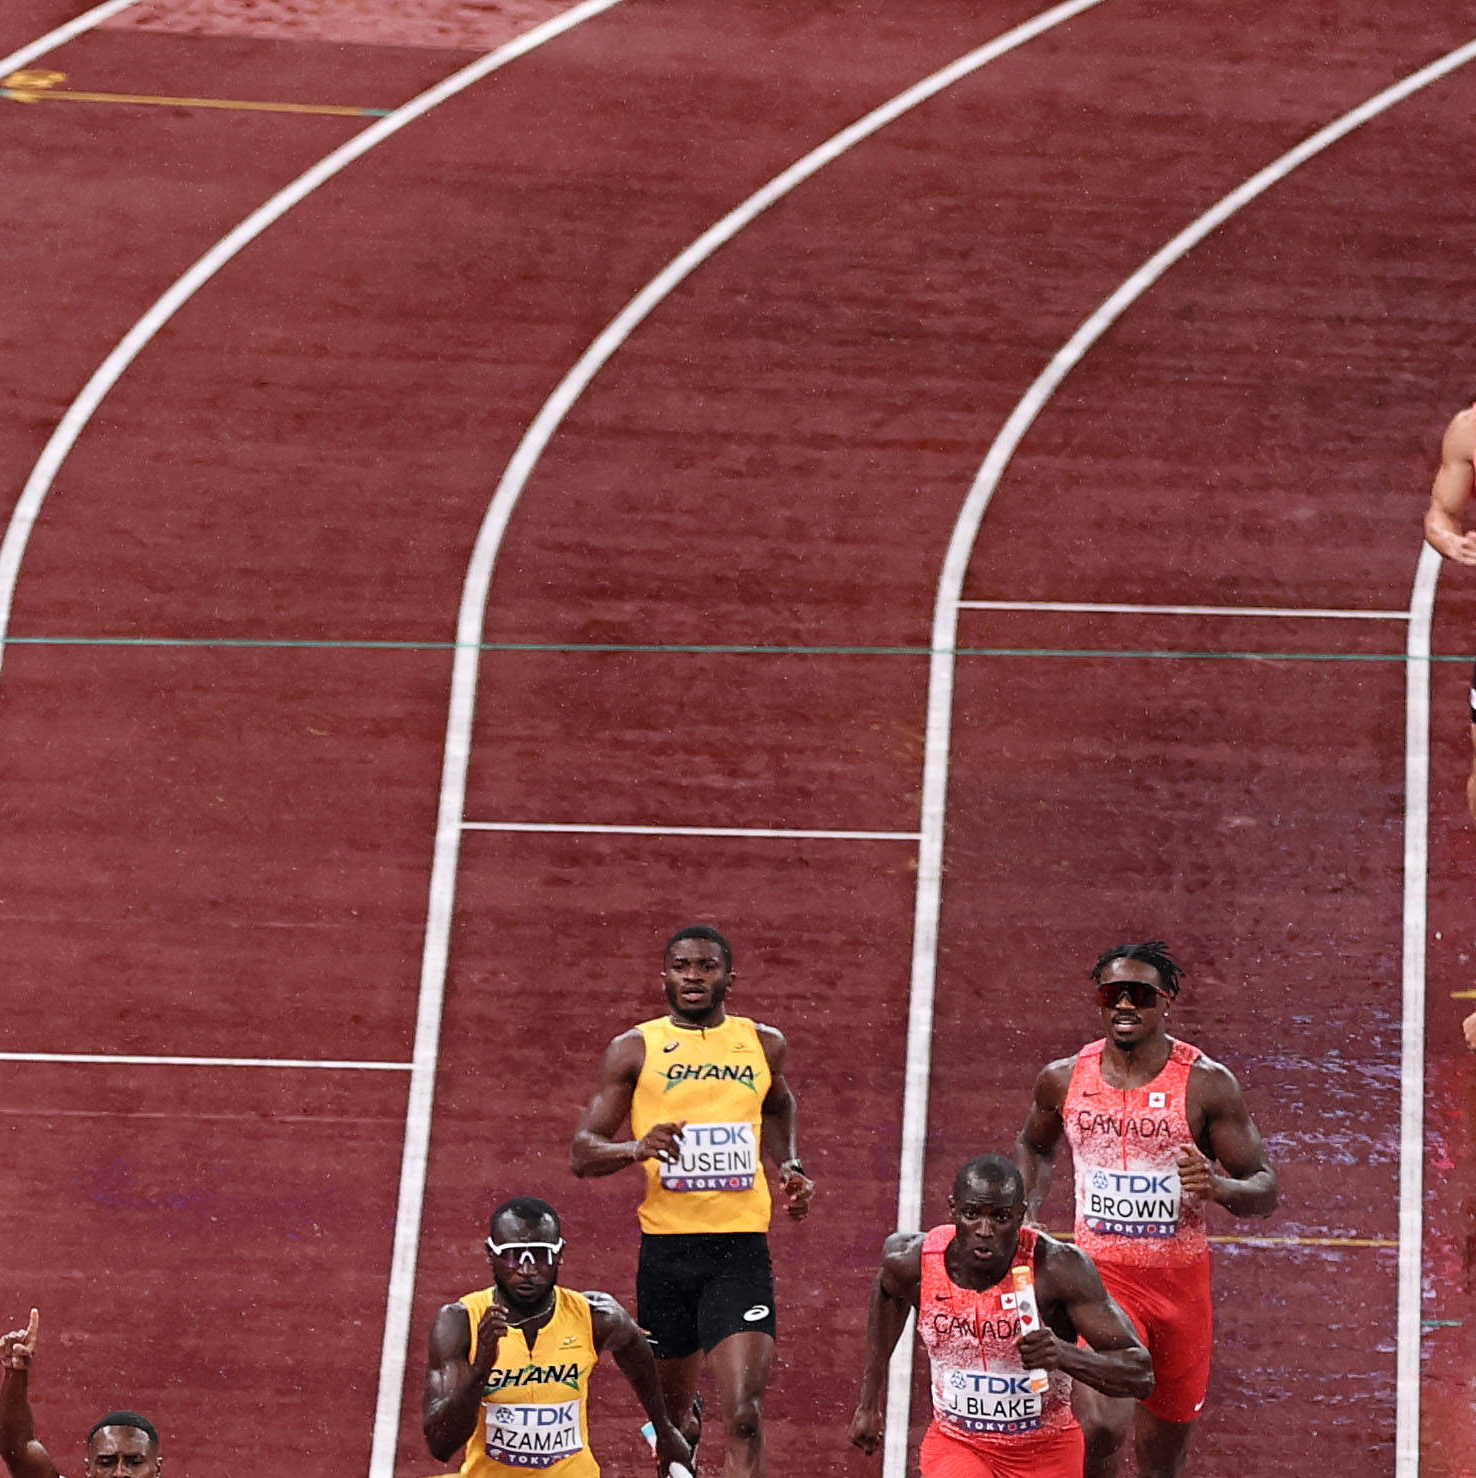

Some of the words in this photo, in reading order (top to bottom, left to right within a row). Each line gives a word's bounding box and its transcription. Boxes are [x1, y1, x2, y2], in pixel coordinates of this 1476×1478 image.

[667, 1063, 755, 1080] GHANA
[1078, 1111, 1171, 1138] CANADA
[687, 1127, 748, 1146] TDK
[1109, 1173, 1174, 1194] TDK
[1091, 1194, 1174, 1218] BROWN
[933, 1313, 1022, 1340] CANADA
[486, 1363, 579, 1388] GHANA
[966, 1374, 1031, 1394] TDK
[515, 1404, 573, 1426] TDK
[949, 1396, 962, 1413] J.
[966, 1398, 1036, 1419] BLAKE
[492, 1427, 575, 1451] AZAMATI
